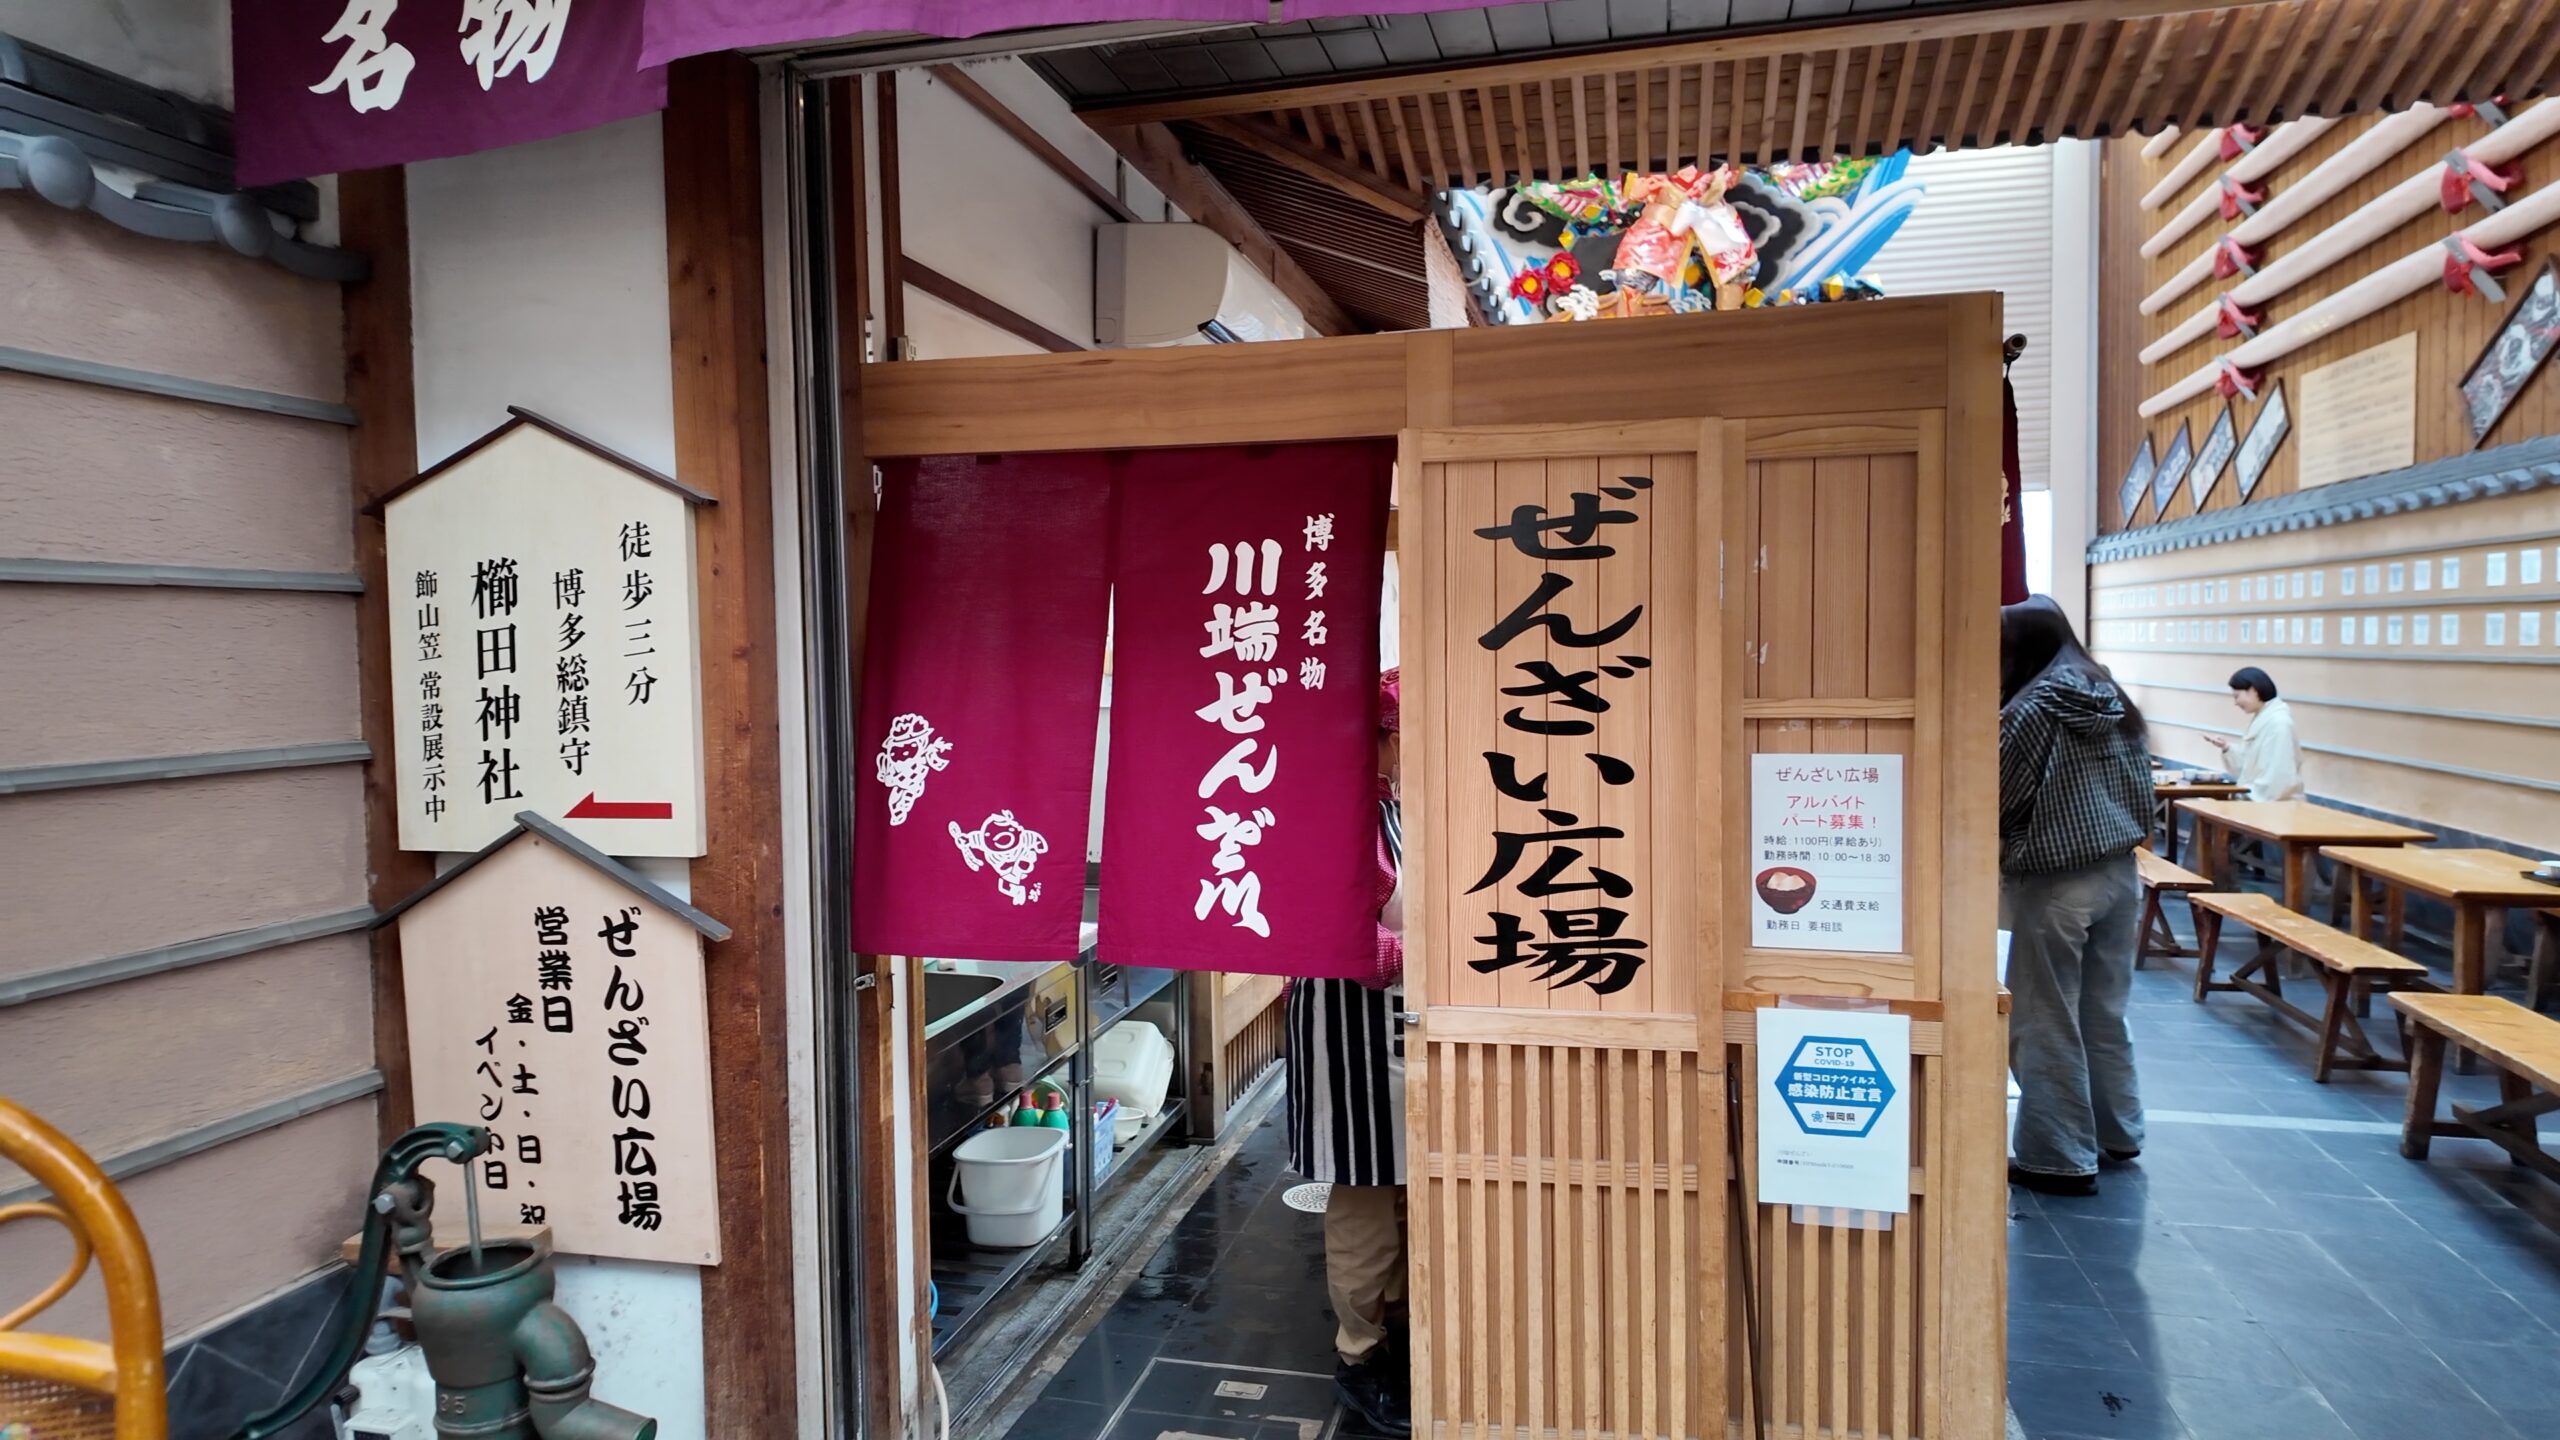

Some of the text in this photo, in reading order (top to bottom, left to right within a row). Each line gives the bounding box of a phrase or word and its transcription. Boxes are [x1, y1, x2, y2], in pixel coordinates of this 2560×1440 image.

[618, 521, 658, 706] 徒歩三分
[1299, 512, 1335, 691] 博多名物
[471, 557, 524, 805] 櫛田神社
[553, 568, 591, 777] 博多総鎮守
[1194, 538, 1288, 938] 川端ぜんざい
[1463, 477, 1654, 995] ぜんざい広場
[1775, 767, 1880, 784] ぜんざい広場
[1786, 795, 1865, 810] アルバイト
[1820, 900, 1880, 912] 交通費支給
[534, 906, 574, 1034] 営業日
[597, 906, 662, 1232] ぜんざい広場
[1793, 1071, 1877, 1085] 新型コロナウイルス
[1814, 1058, 1855, 1067] COVID-19
[1815, 1046, 1854, 1058] STOP
[1787, 1083, 1883, 1103] 感染防止宣言
[1826, 1111, 1856, 1122] 福岡県
